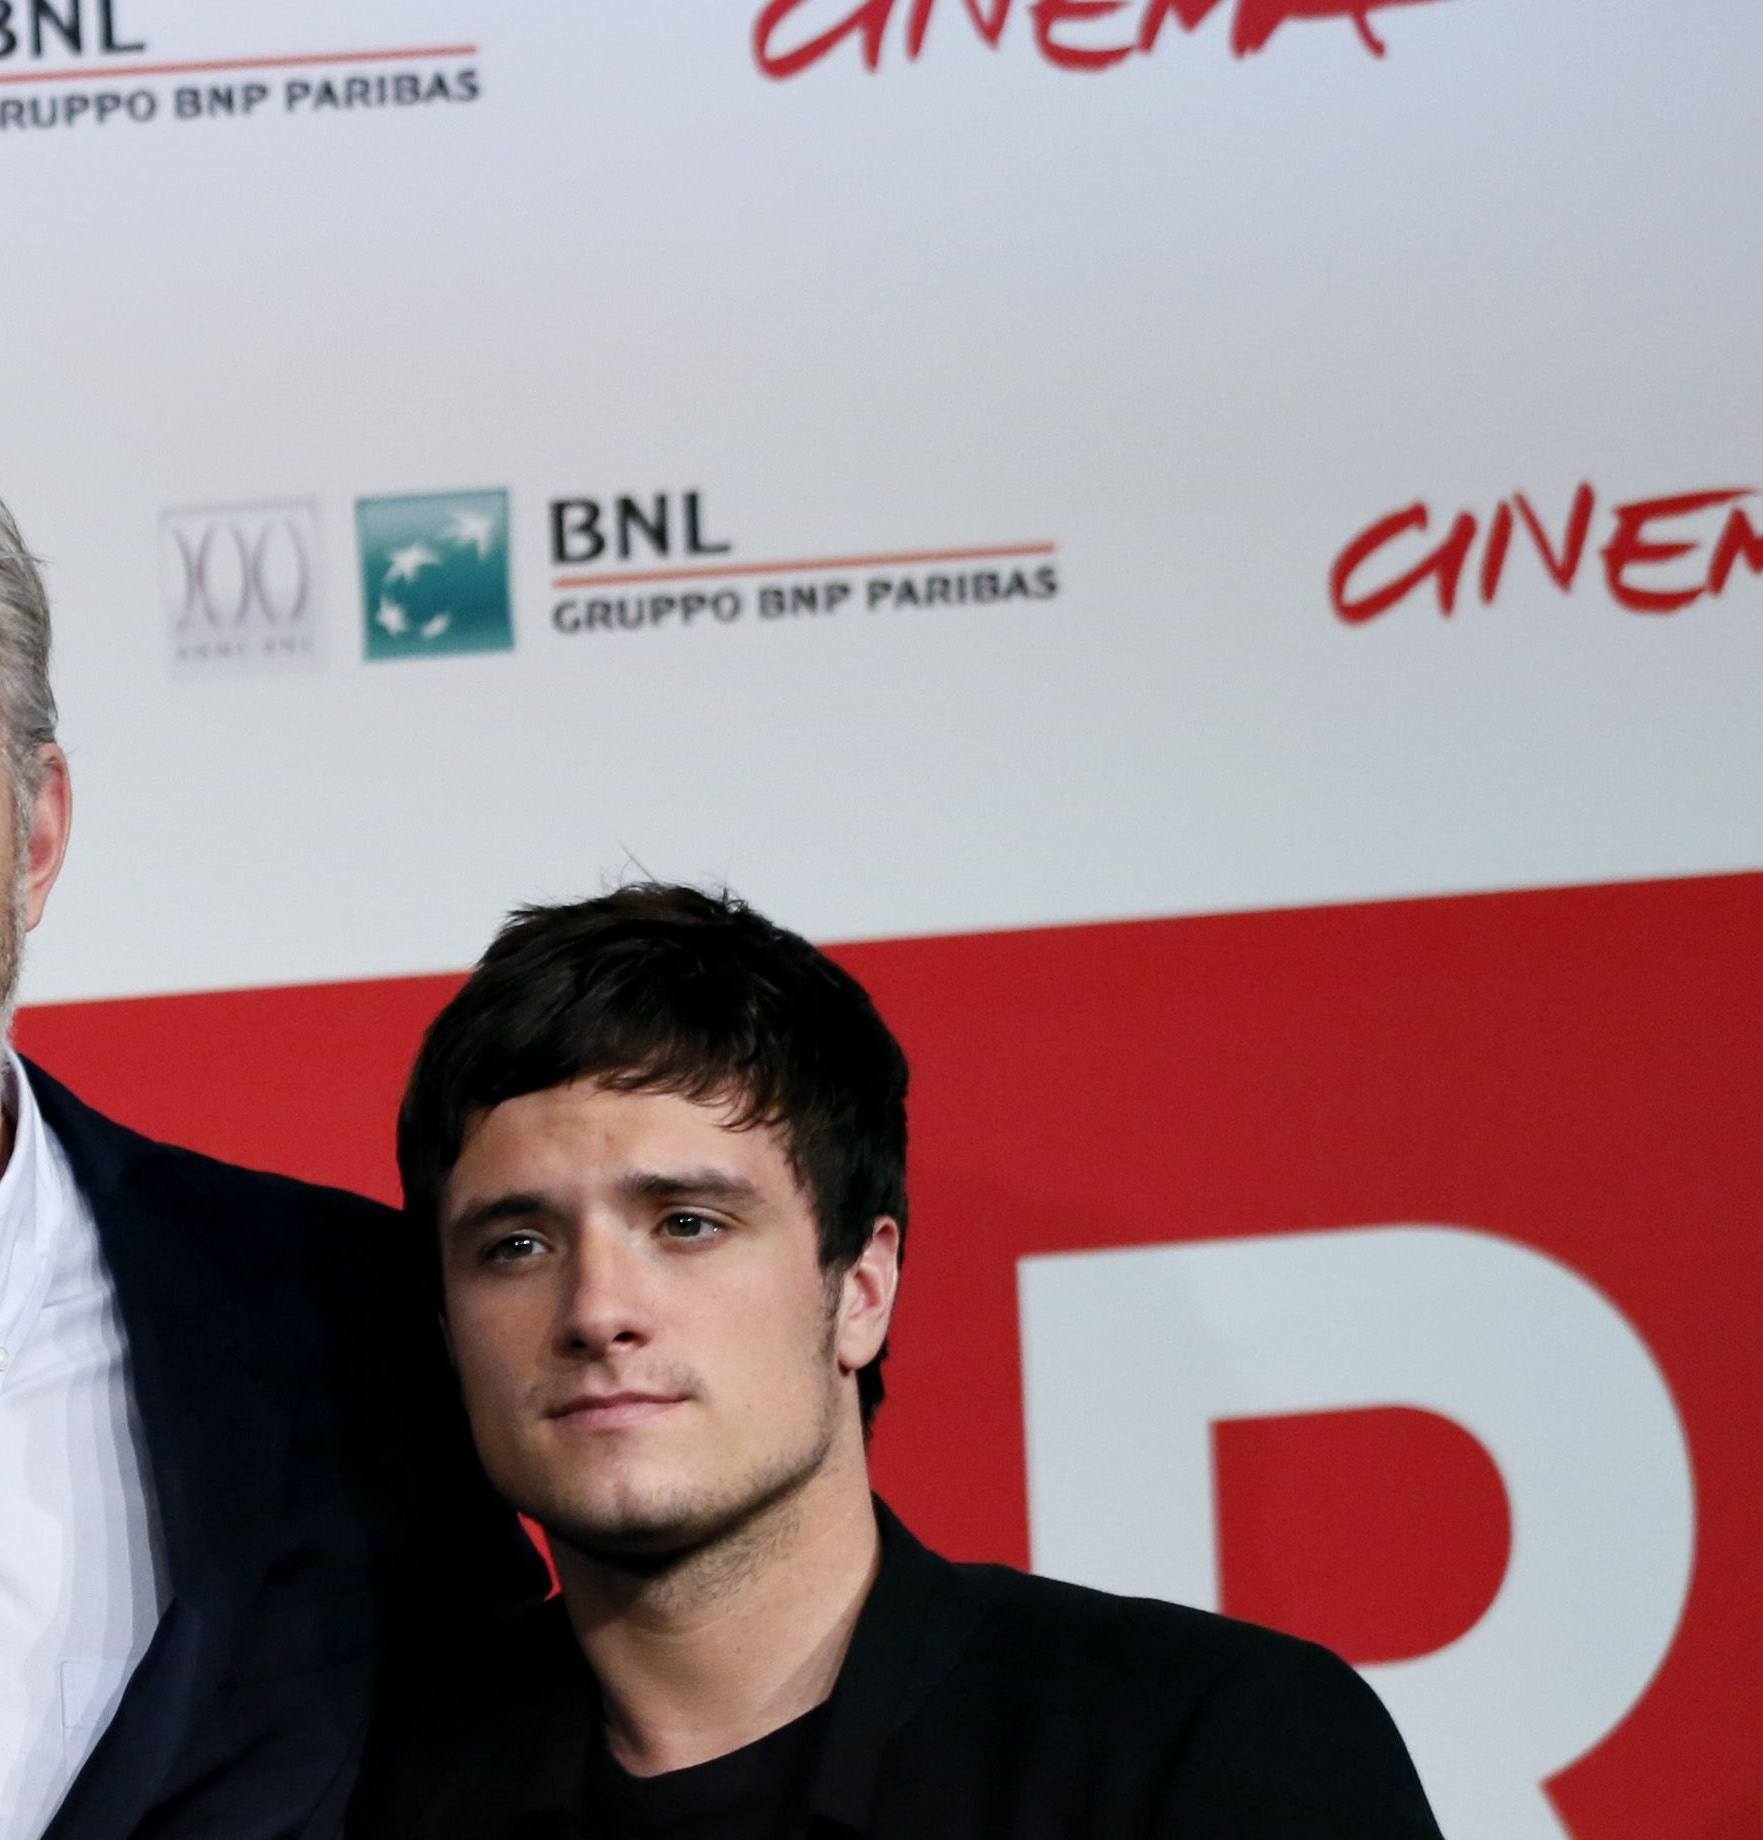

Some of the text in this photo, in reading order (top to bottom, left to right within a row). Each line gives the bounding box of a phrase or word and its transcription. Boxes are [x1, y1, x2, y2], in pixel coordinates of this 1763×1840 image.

[173, 81, 270, 120] BNP
[284, 69, 481, 113] PARIBAS
[548, 489, 732, 566] BNL
[551, 565, 1059, 634] GRUPPO BNP PARIBAS
